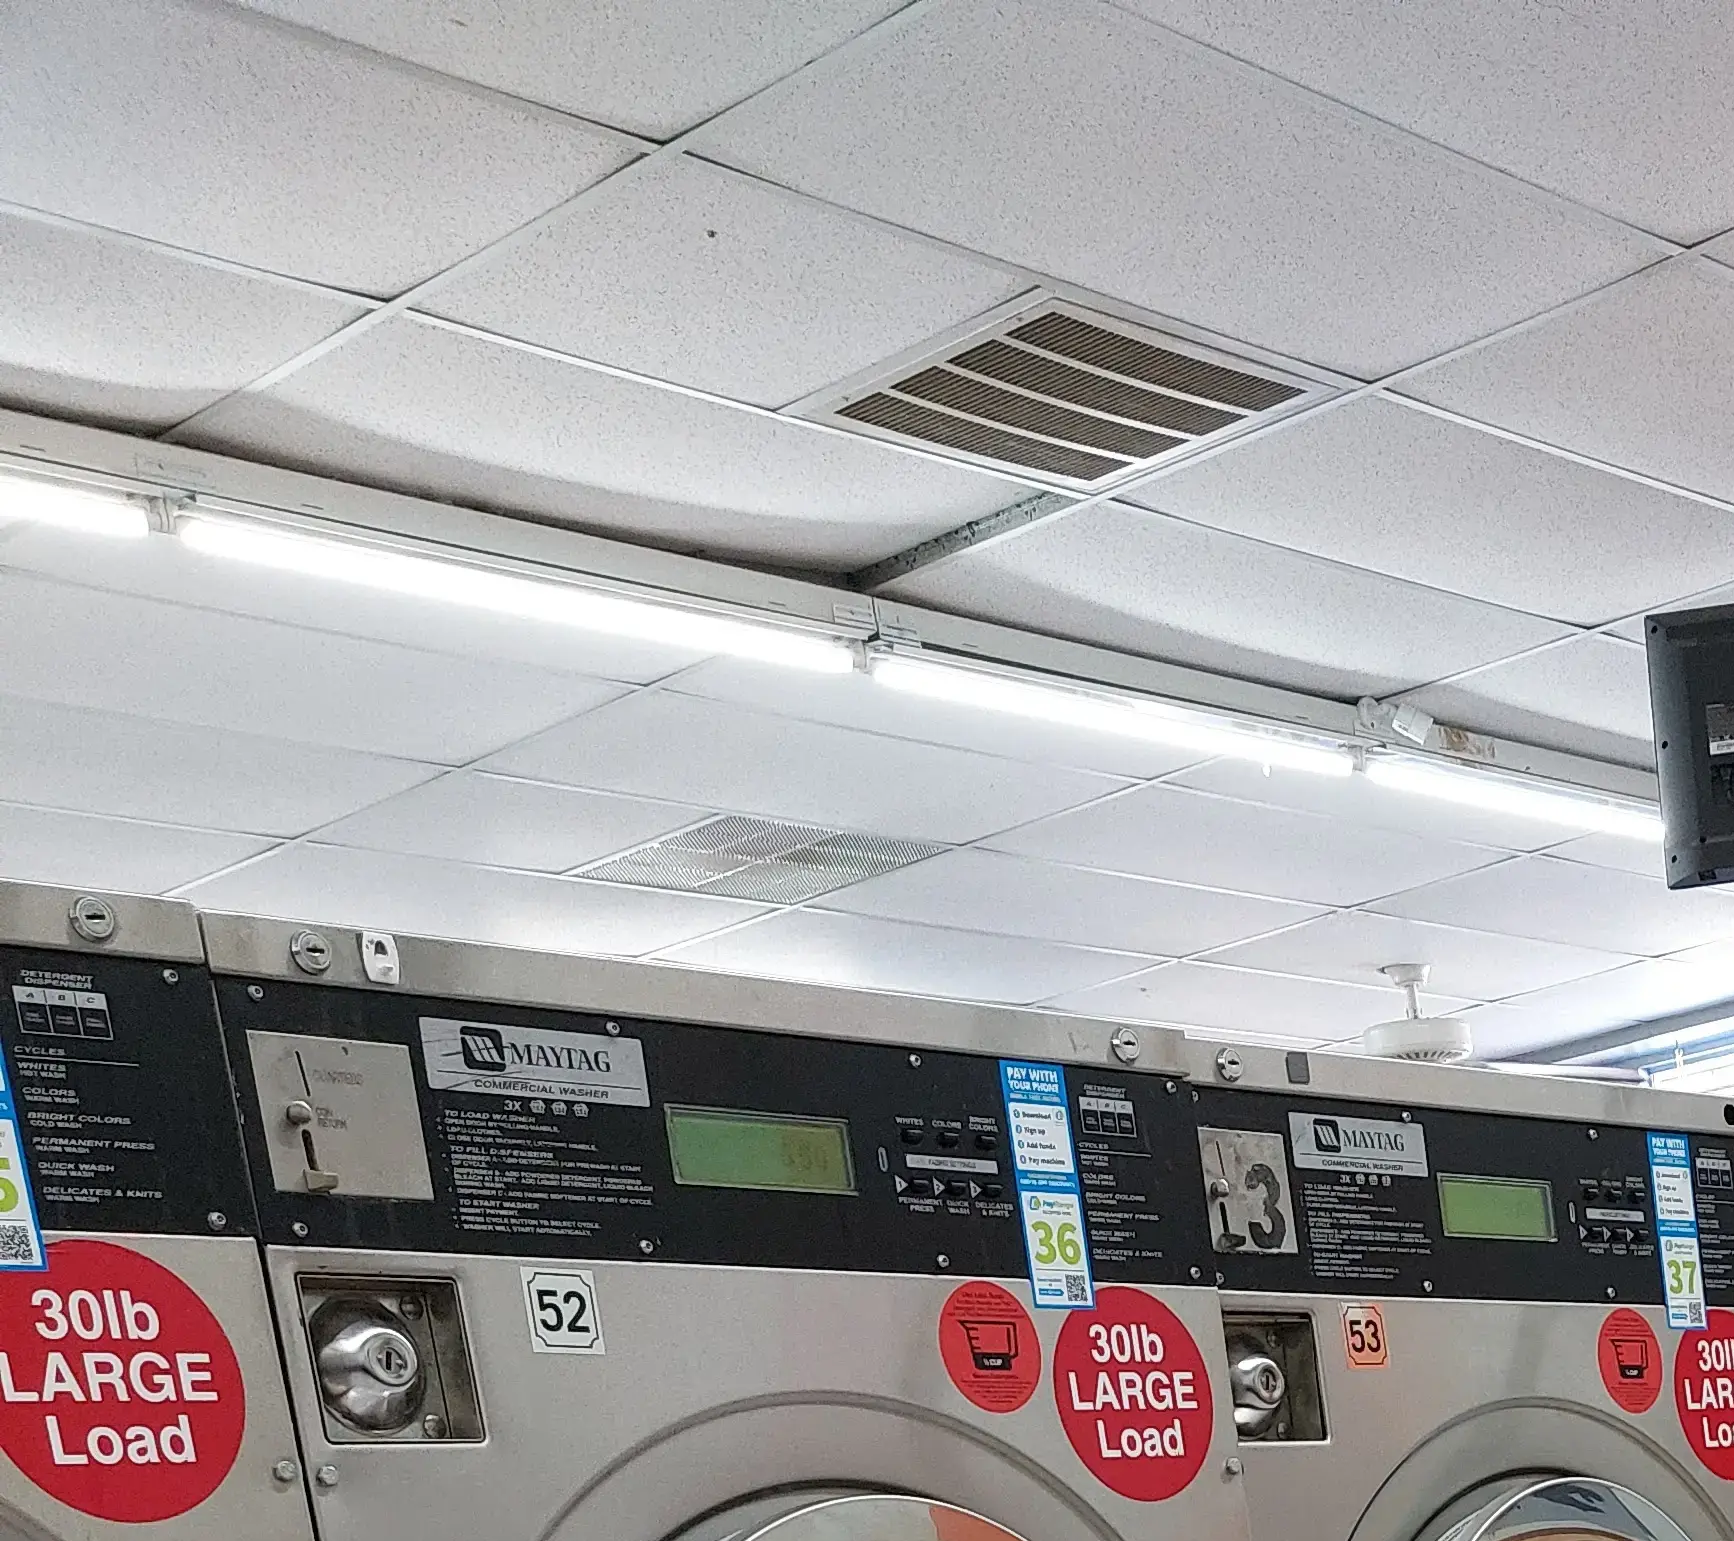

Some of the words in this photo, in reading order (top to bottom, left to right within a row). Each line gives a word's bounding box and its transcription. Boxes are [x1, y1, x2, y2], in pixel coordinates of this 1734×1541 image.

[20, 969, 94, 983] DETERGENT
[25, 977, 92, 990] DISPENSER
[14, 1045, 66, 1056] CYCLES
[508, 1042, 611, 1073] MAYTAG
[17, 1061, 67, 1072] WHITES
[1006, 1067, 1026, 1081] PAY
[1028, 1068, 1058, 1082] WITH
[22, 1086, 77, 1097] COLORS
[474, 1078, 555, 1096] COMMERCIAL
[559, 1087, 609, 1099] WASHER
[1008, 1080, 1031, 1090] YOUR
[1032, 1082, 1059, 1093] PHONE
[503, 1100, 523, 1112] 3X
[27, 1111, 76, 1122] BRIGHT
[78, 1114, 132, 1125] COLORS
[460, 1111, 490, 1119] LOAD
[32, 1136, 111, 1149] PERMANENT
[114, 1141, 155, 1150] PRESS
[1341, 1129, 1405, 1152] MAYTAG
[1666, 1139, 1685, 1150] WITH
[38, 1161, 76, 1170] QUICK
[78, 1163, 115, 1172] WASH
[1322, 1159, 1370, 1169] COMMERCIAL
[1372, 1163, 1403, 1172] WASHER
[43, 1186, 112, 1197] DELICATES
[126, 1190, 163, 1199] KNITS
[975, 1201, 1014, 1211] DELICATES
[1031, 1220, 1081, 1265] 36
[1667, 1260, 1697, 1294] 37
[31, 1289, 160, 1341] 30lb
[536, 1291, 591, 1334] 52
[1349, 1318, 1382, 1354] 53
[1090, 1323, 1165, 1364] 30lb
[0, 1353, 219, 1404] LARGE
[1067, 1371, 1198, 1412] LARGE
[45, 1416, 196, 1466] Load
[1097, 1420, 1185, 1459] Load
